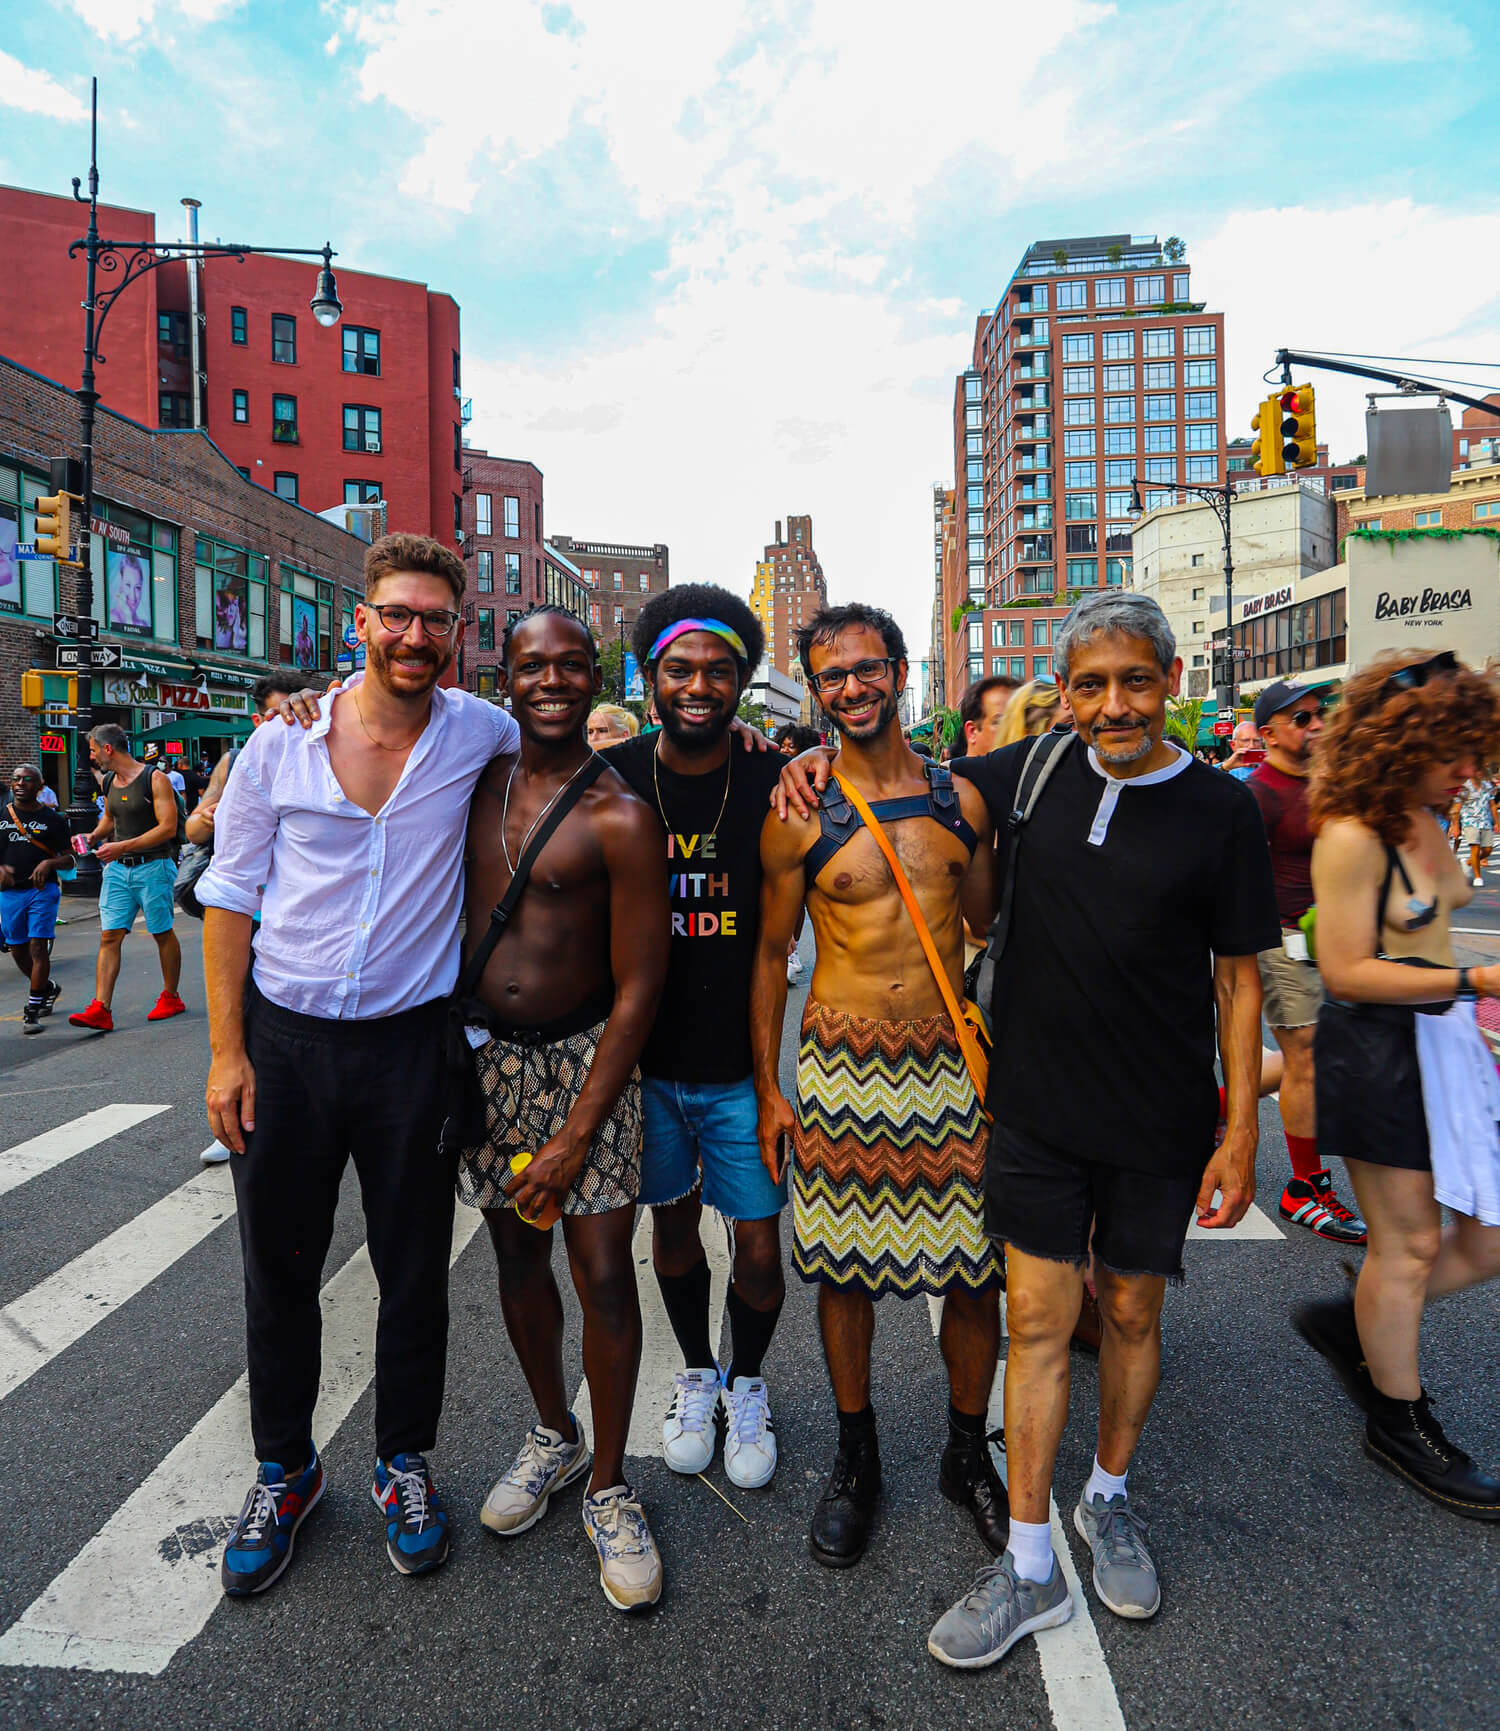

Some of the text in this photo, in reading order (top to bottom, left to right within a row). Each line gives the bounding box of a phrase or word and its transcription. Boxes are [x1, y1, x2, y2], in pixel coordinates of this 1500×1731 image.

[92, 519, 130, 544] 7 AV SOUTH
[1243, 587, 1292, 618] BABY BRASA
[1375, 588, 1472, 620] BABY BRASA
[60, 621, 73, 632] ONE
[67, 651, 111, 661] ON WAY
[159, 684, 210, 710] PIZZA
[667, 834, 717, 858] IVE
[669, 873, 729, 897] ITH
[671, 911, 737, 937] RIDE
